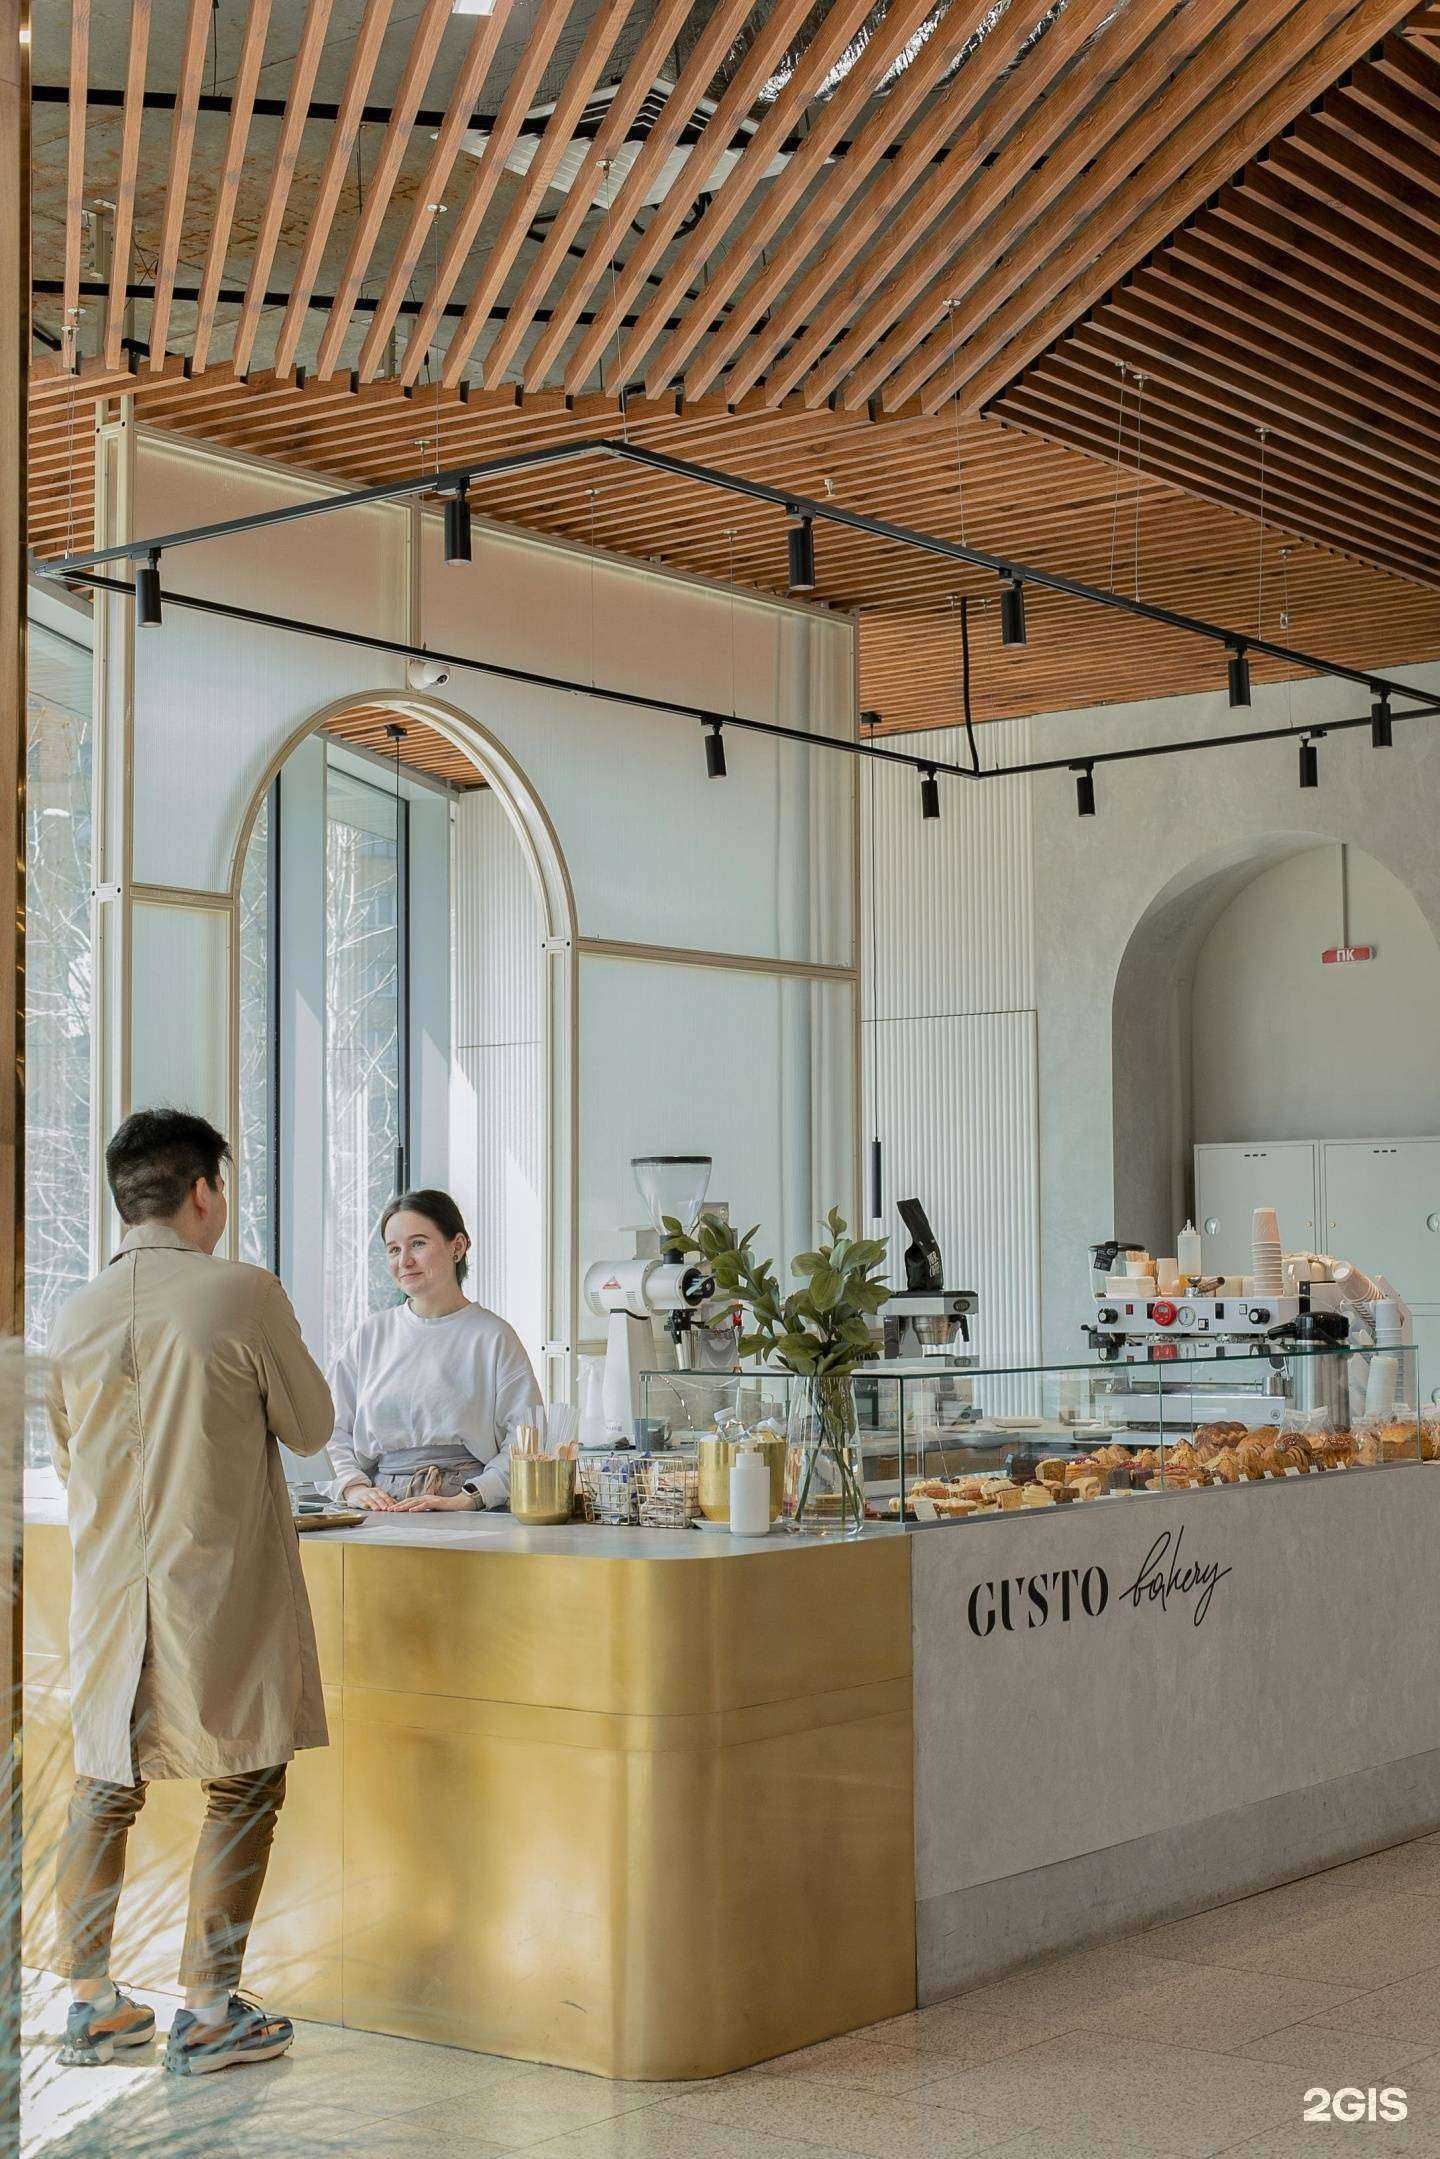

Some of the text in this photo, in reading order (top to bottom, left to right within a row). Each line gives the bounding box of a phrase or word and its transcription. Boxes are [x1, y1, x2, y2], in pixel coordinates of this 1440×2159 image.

[1336, 948, 1355, 962] ПК
[967, 1525, 1233, 1637] GUSTO bakery
